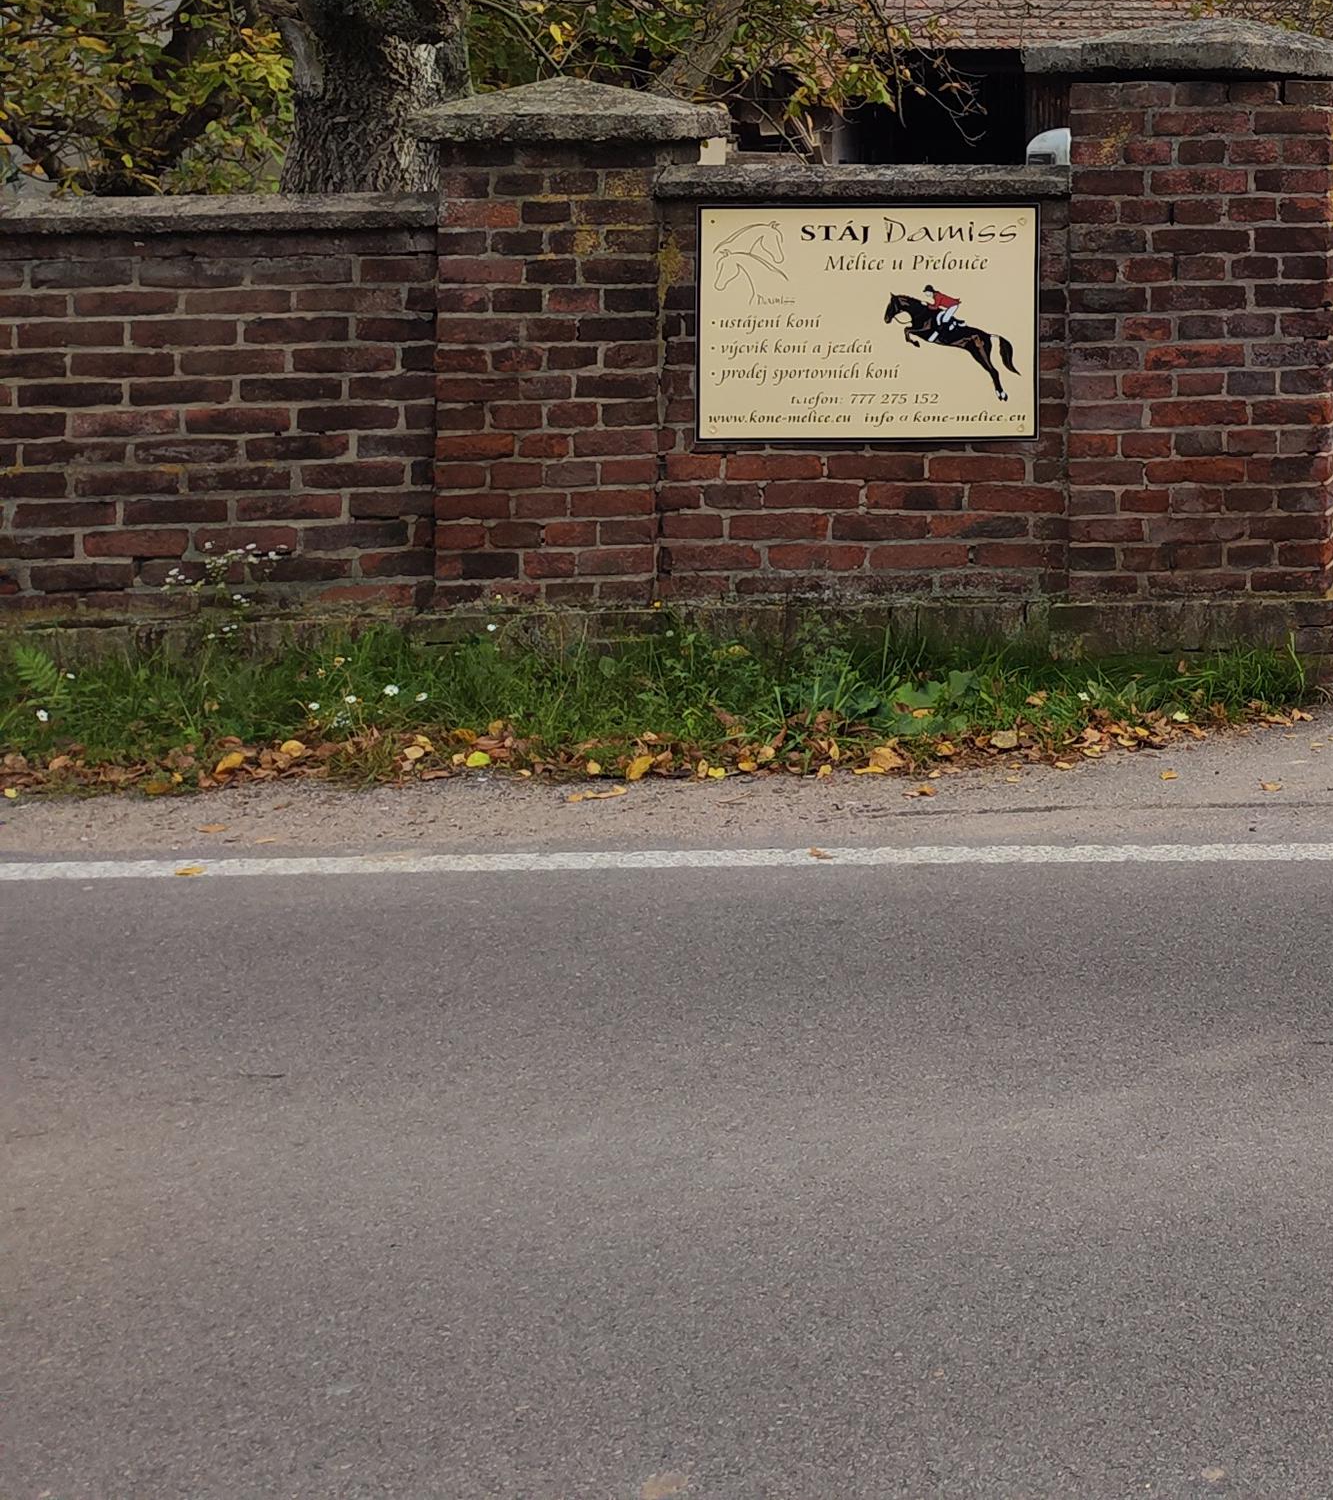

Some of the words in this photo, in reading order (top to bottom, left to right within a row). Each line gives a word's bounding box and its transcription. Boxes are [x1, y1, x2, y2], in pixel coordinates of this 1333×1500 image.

[800, 220, 870, 245] STÁJ
[883, 217, 1017, 243] Damiss
[824, 252, 885, 271] Mělice
[892, 259, 903, 271] u
[912, 251, 989, 271] Přelouče
[719, 314, 782, 335] ustájení
[786, 313, 822, 329] koní
[721, 338, 768, 360] výcvik
[773, 338, 808, 354] koní
[811, 344, 822, 354] a
[821, 338, 873, 360] jezdců
[715, 362, 768, 386] prodej
[772, 362, 860, 386] sportovních
[865, 362, 901, 379] koní
[850, 393, 877, 405] 777
[880, 393, 908, 405] 275
[913, 393, 940, 405] 152
[708, 410, 852, 424] www.kone-melice.eu
